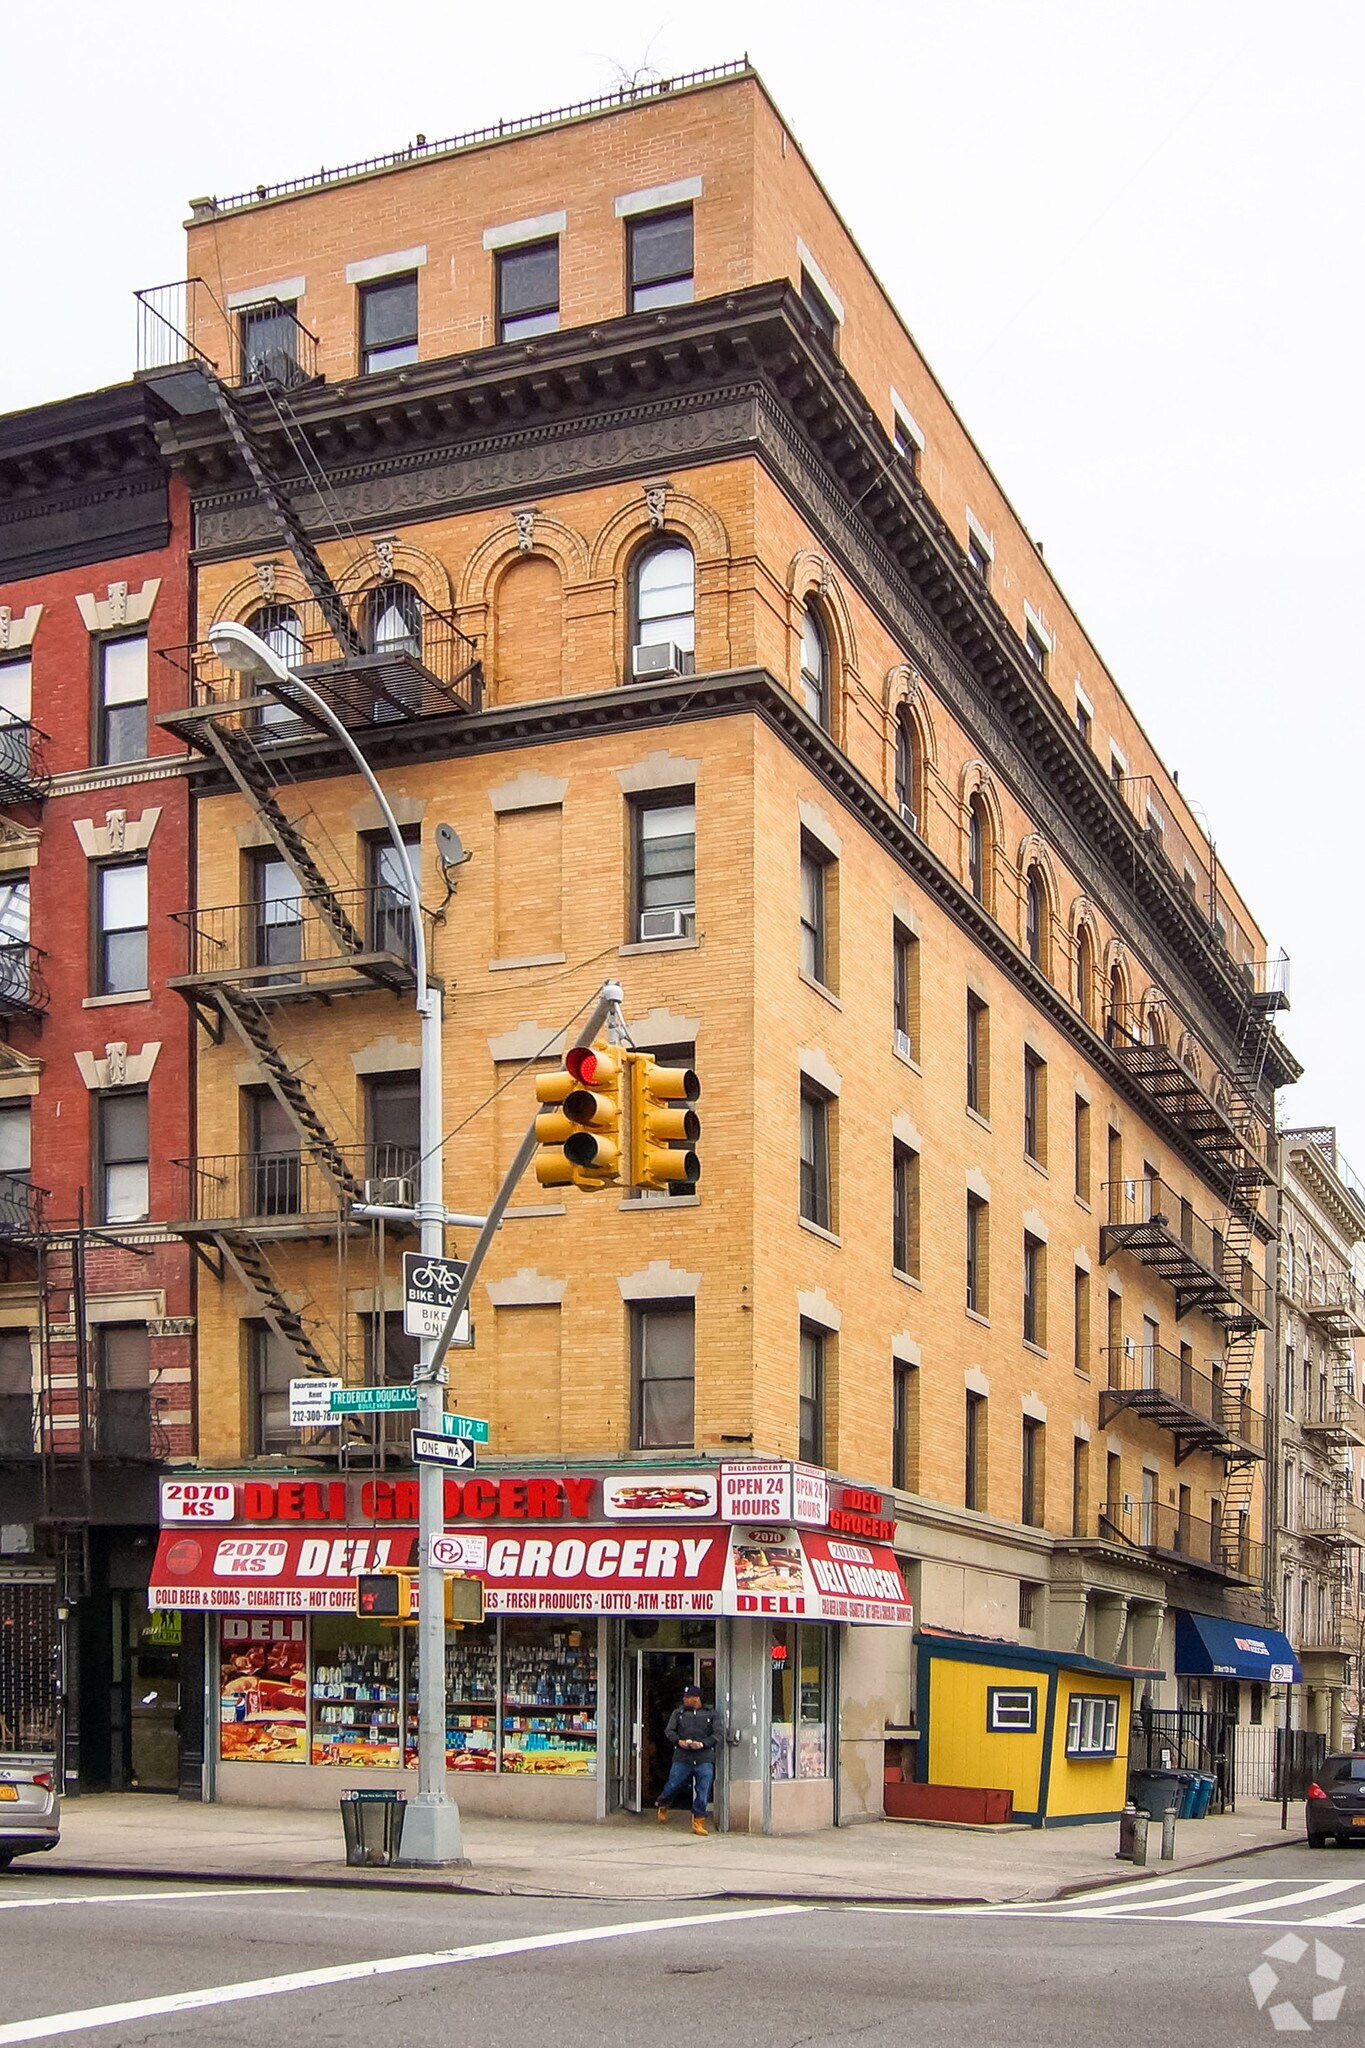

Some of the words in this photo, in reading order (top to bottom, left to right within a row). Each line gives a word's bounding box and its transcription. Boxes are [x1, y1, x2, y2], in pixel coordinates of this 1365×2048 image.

[408, 1289, 434, 1302] BIKE
[438, 1293, 461, 1306] LA
[424, 1322, 445, 1333] ONL
[333, 1389, 373, 1405] FREDERICK
[376, 1388, 417, 1403] DOUGLASS
[358, 1402, 390, 1410] BOULEVARD
[445, 1416, 453, 1434] W
[458, 1419, 473, 1438] 112
[476, 1423, 484, 1432] ST
[421, 1441, 439, 1455] ONE
[447, 1444, 465, 1459] WAY
[746, 1464, 783, 1472] GROCERY
[167, 1485, 229, 1500] 2070
[727, 1478, 764, 1495] OPEN
[766, 1478, 784, 1495] 24
[796, 1478, 812, 1497] OPEN
[813, 1483, 823, 1499] 24
[244, 1482, 346, 1520] DELI
[361, 1478, 595, 1519] GROCERY
[731, 1499, 780, 1516] HOURS
[843, 1488, 882, 1514] DELI
[182, 1502, 214, 1516] KS
[797, 1499, 821, 1519] HOURS
[829, 1509, 897, 1540] GROCERY
[753, 1532, 781, 1543] 2070
[218, 1543, 286, 1556] 2070
[296, 1539, 391, 1577] DELI
[487, 1539, 713, 1577] GROCERY
[832, 1544, 856, 1560] 2070
[857, 1550, 870, 1562] KS
[231, 1558, 266, 1572] KS
[810, 1558, 848, 1594] DELI
[842, 1563, 905, 1600] GROCERY
[155, 1589, 177, 1605] COLD
[180, 1590, 201, 1605] BEER
[202, 1592, 208, 1604] &
[211, 1590, 240, 1606] SODAS
[247, 1591, 301, 1606] CIGARETTES
[309, 1591, 328, 1607] HOT
[329, 1591, 356, 1607] COFFE
[506, 1592, 537, 1608] FRESH
[539, 1593, 592, 1609] PRODUCTS
[601, 1593, 630, 1609] LOTTO
[691, 1594, 713, 1610] WIC
[737, 1595, 805, 1614] DELI
[223, 1619, 303, 1641] DELI
